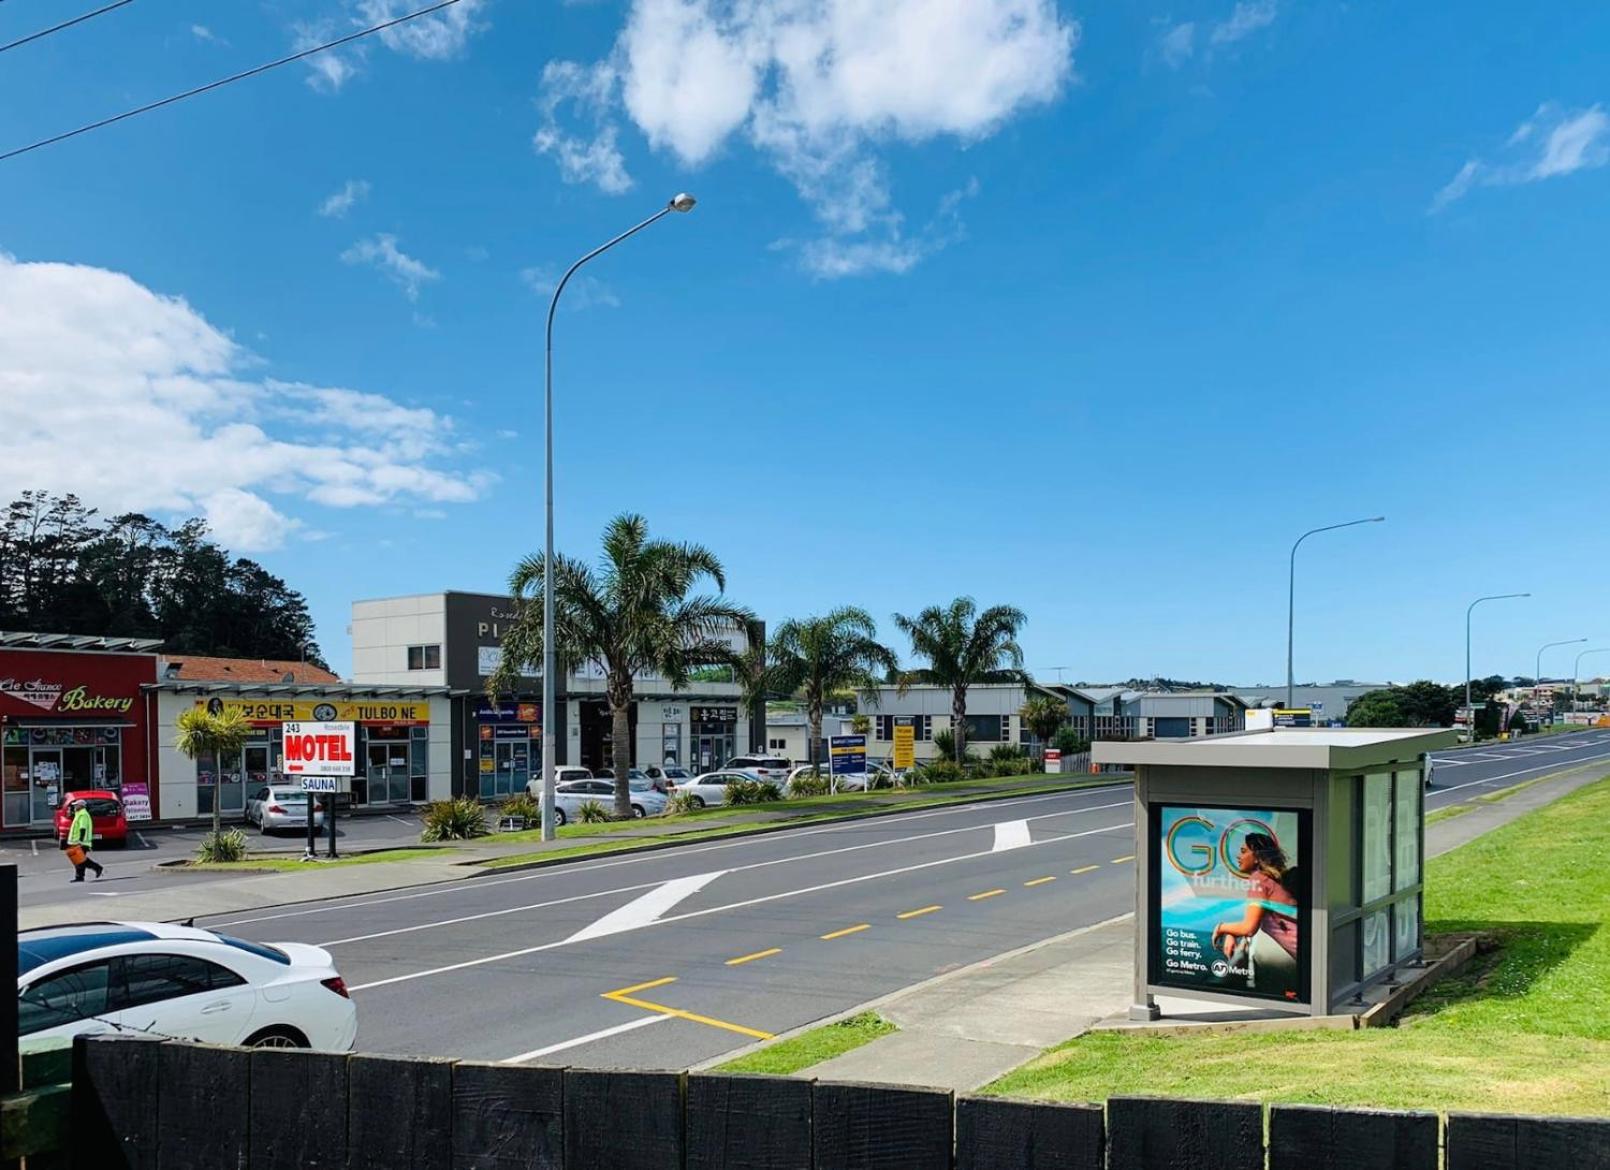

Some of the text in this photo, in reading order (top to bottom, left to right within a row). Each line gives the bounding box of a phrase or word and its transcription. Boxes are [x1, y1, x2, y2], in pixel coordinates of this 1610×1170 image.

[58, 686, 133, 712] Bakery
[358, 706, 397, 719] TULBO
[401, 707, 417, 719] NE
[286, 723, 300, 733] 243
[285, 734, 352, 761] MOTEL
[302, 778, 335, 790] SAUNA
[1166, 816, 1280, 879] GO
[1193, 870, 1262, 891] further.
[1166, 929, 1197, 939] Go bus.
[1166, 938, 1201, 949] Go train.
[1166, 947, 1202, 959] Go ferry.
[1166, 959, 1208, 971] Go Metro.
[1229, 965, 1255, 976] Metro
